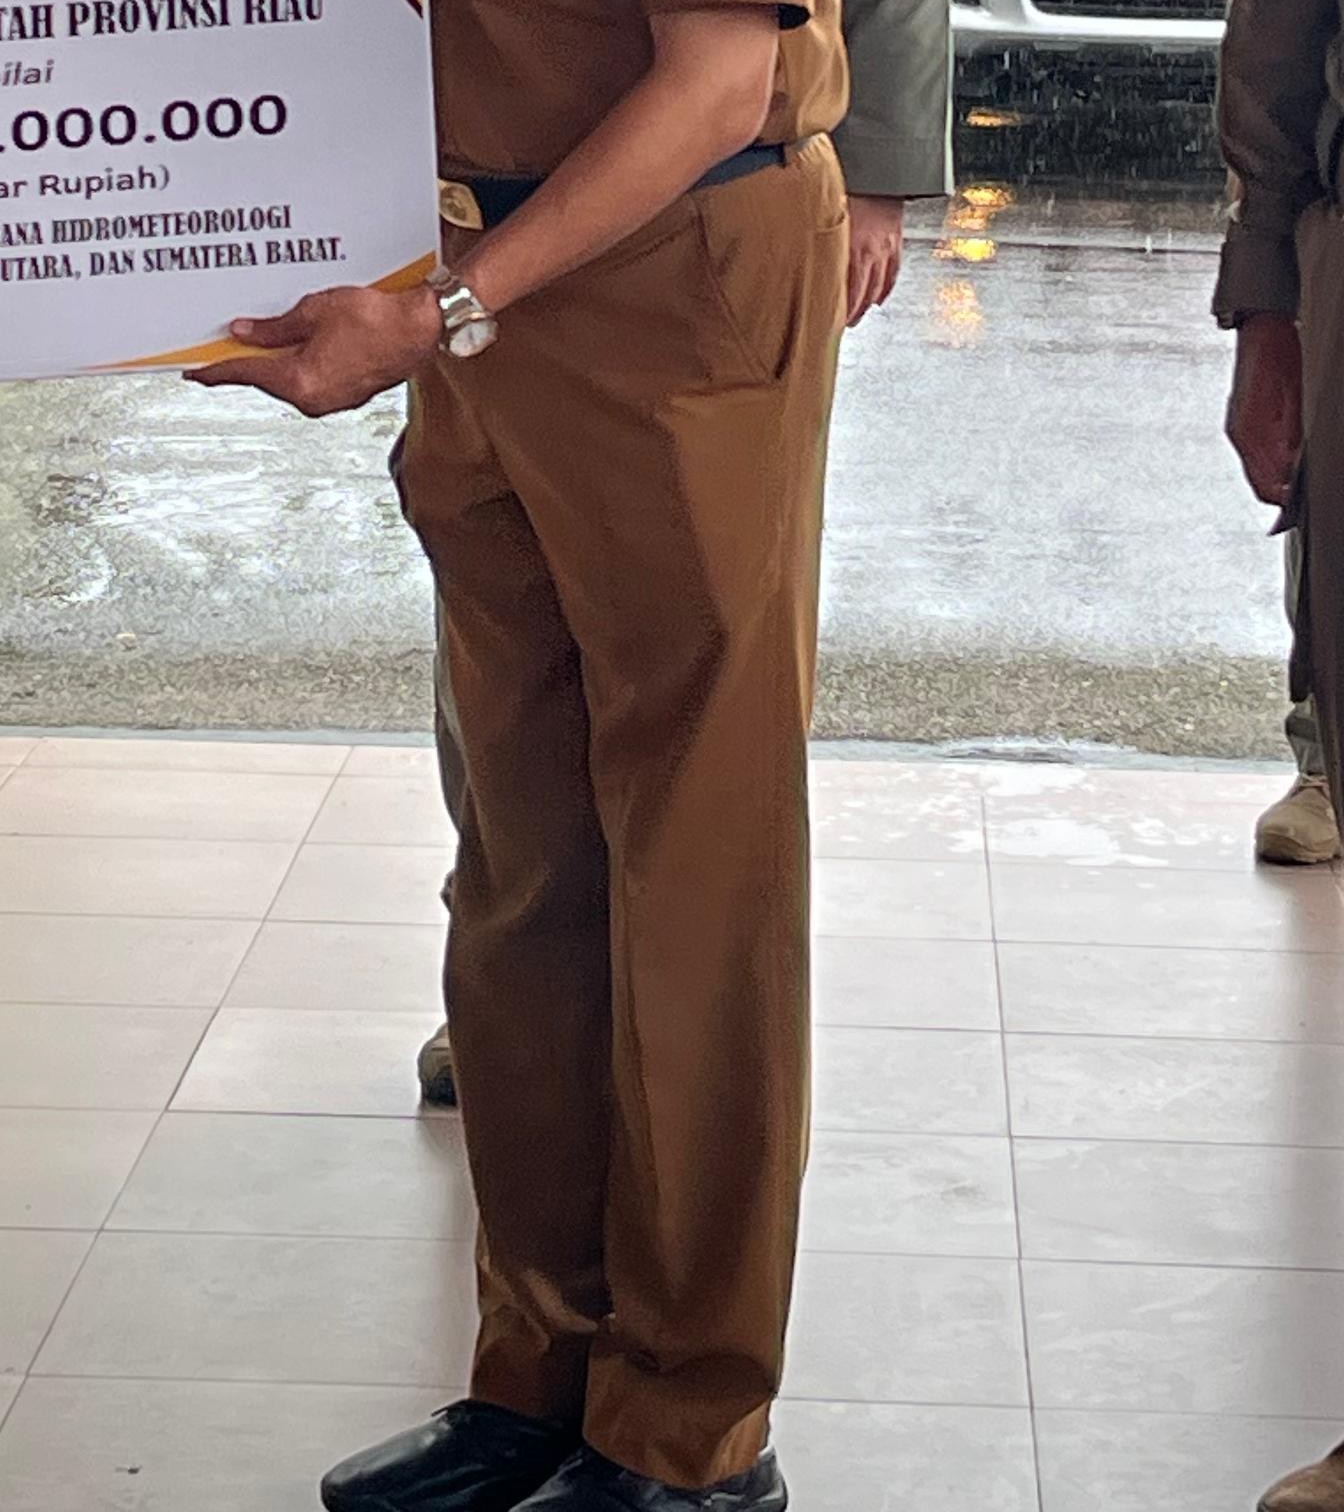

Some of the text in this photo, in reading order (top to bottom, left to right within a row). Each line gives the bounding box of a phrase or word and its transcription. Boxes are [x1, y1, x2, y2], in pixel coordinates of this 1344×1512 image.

[39, 164, 170, 200] Rupiah)
[51, 205, 292, 245] HIDROMETEOROLOGI
[0, 255, 82, 282] UTARA,
[90, 249, 136, 277] DAN
[143, 242, 258, 273] SUMATERA
[265, 237, 347, 265] BARAT.
